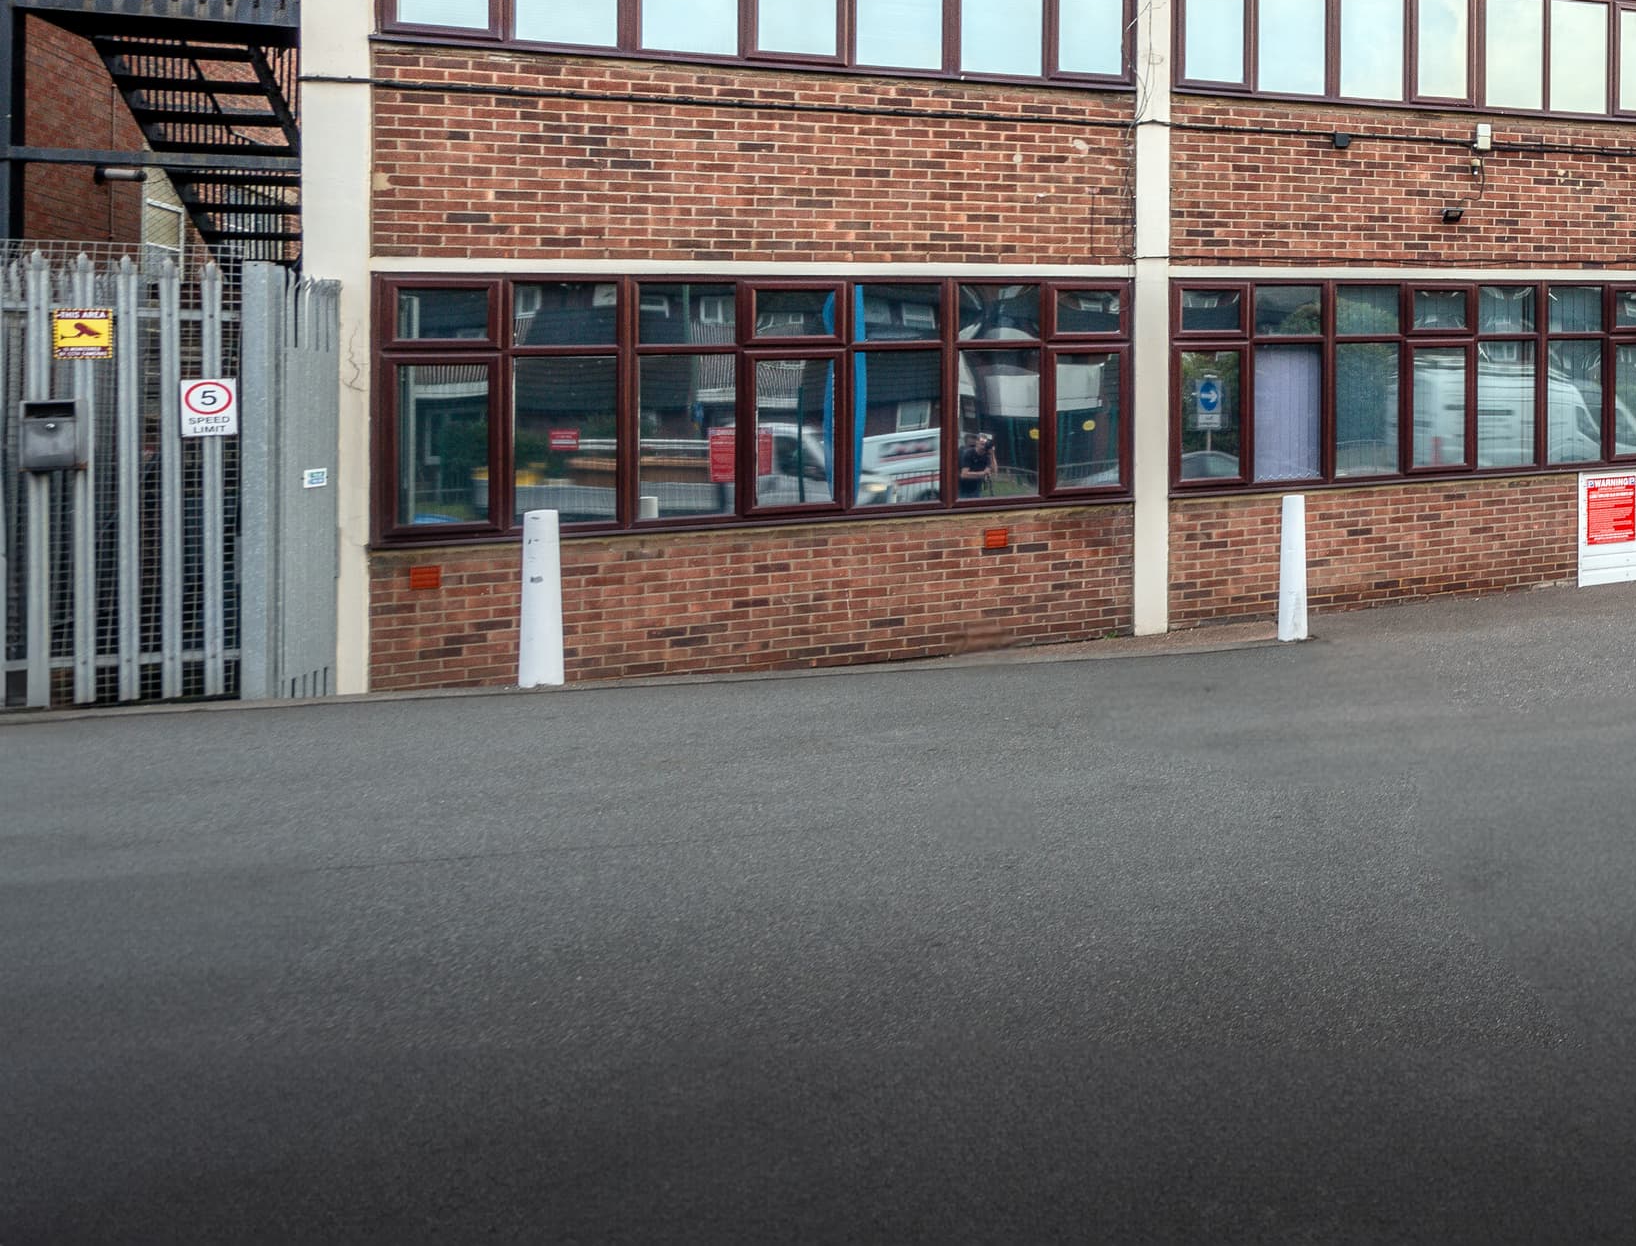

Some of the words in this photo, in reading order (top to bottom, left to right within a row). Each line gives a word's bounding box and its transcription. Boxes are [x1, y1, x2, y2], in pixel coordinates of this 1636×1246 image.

[201, 390, 217, 406] 5
[189, 416, 230, 425] SPEED
[193, 425, 226, 434] LIMIT
[1594, 477, 1629, 488] WARNING
